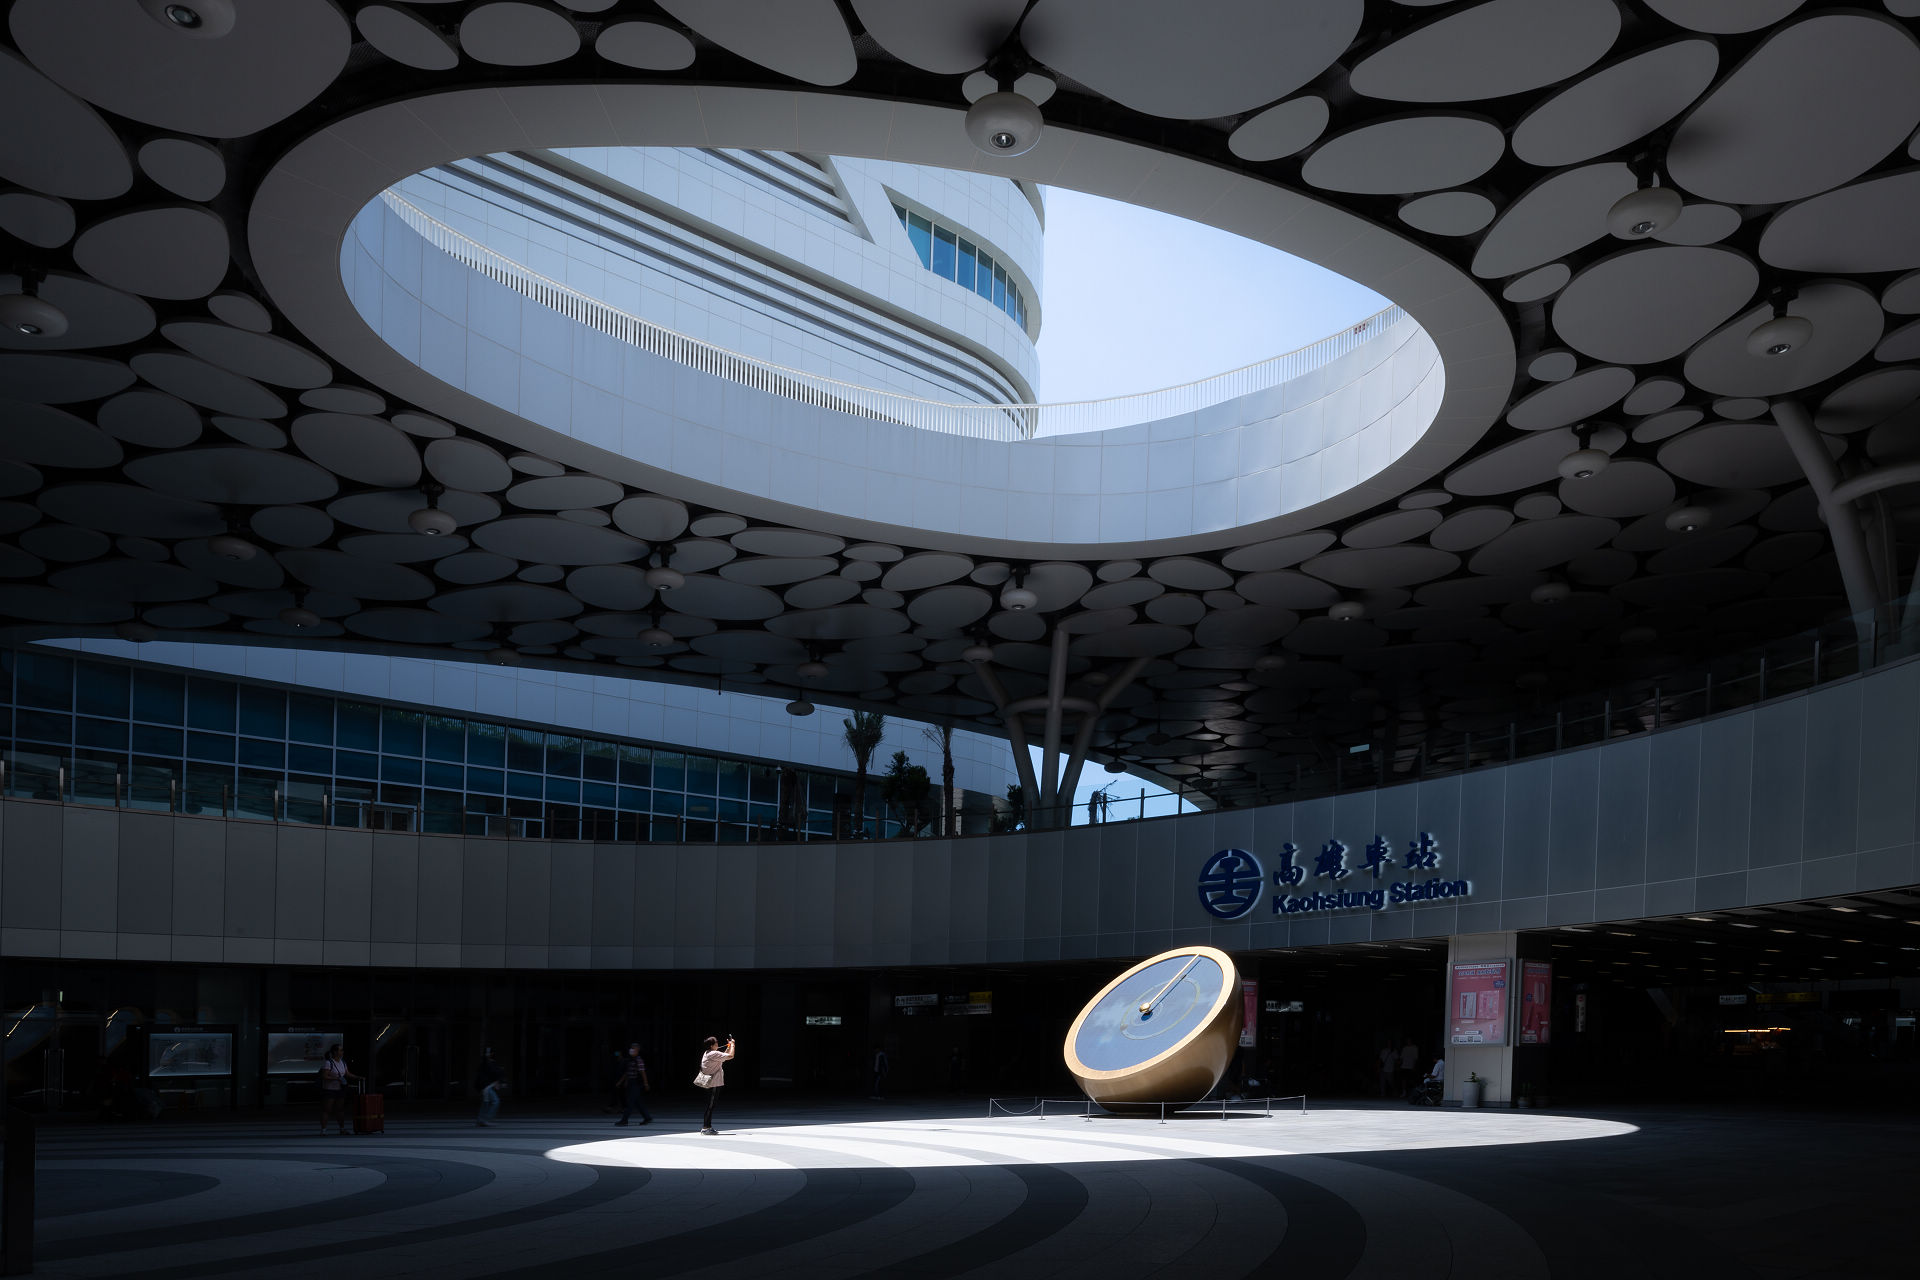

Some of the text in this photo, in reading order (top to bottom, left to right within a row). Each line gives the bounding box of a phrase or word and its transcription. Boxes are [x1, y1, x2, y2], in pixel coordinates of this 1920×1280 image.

[1273, 832, 1438, 886] 高雄車站
[1272, 877, 1469, 914] Kaohsiung Station
